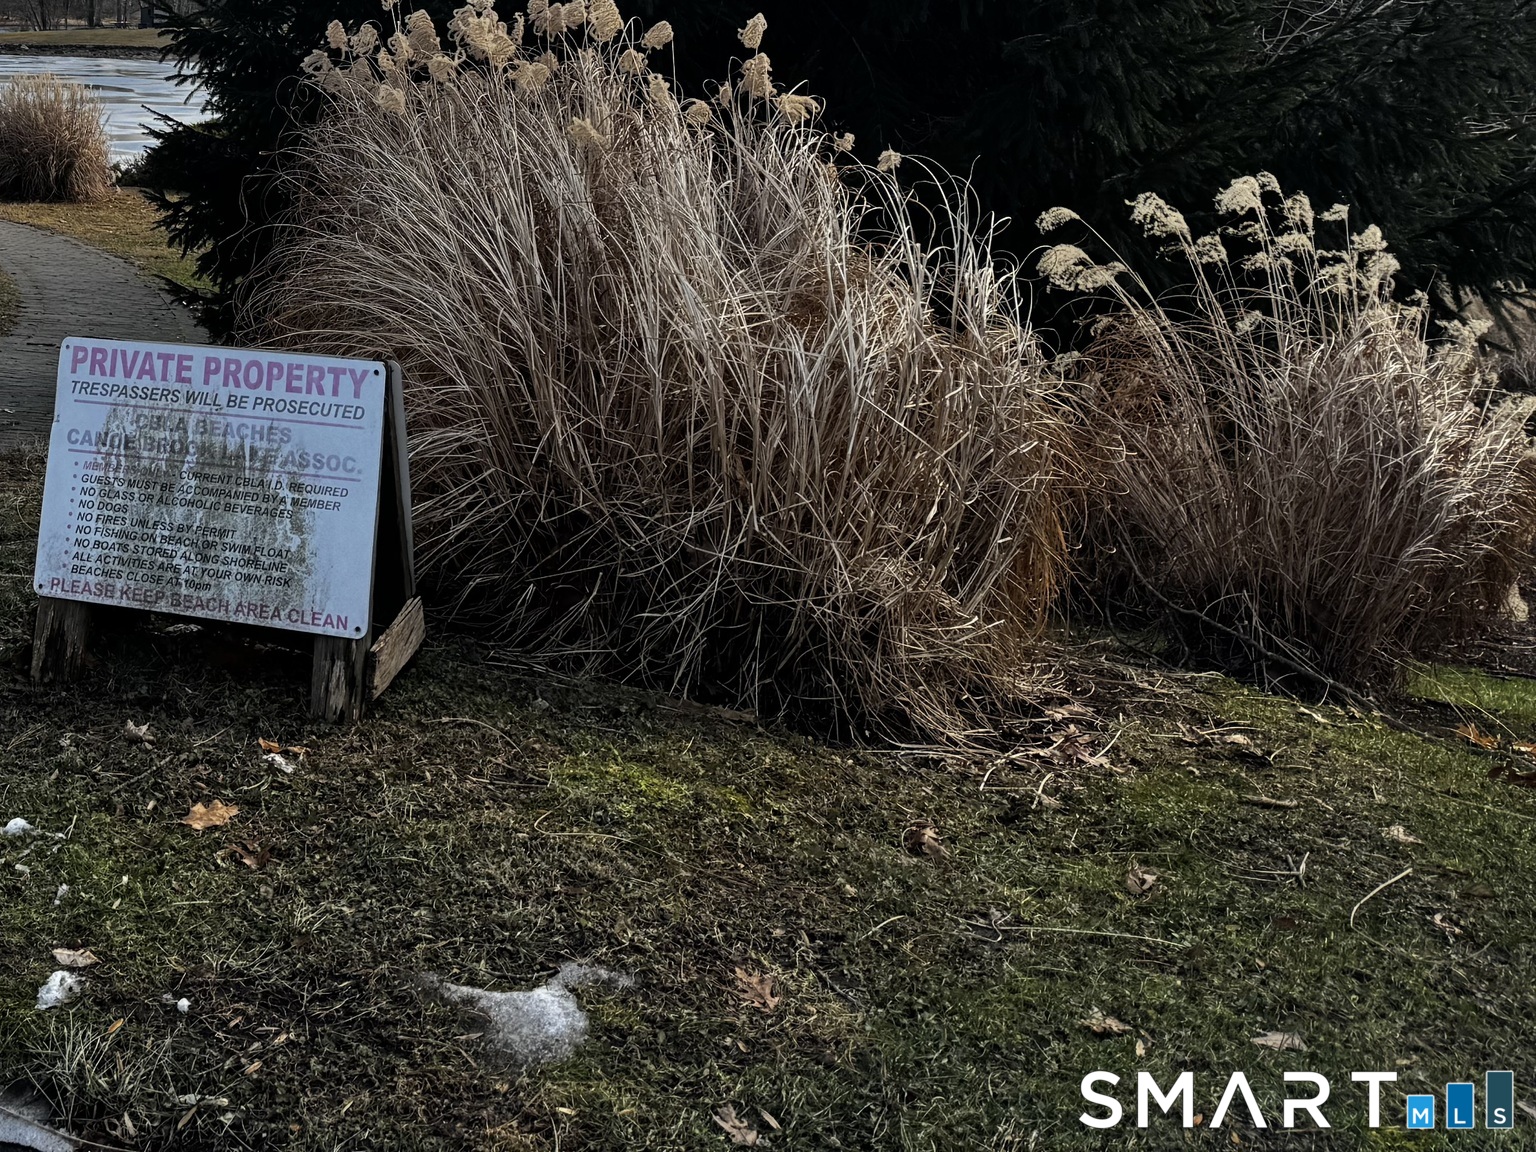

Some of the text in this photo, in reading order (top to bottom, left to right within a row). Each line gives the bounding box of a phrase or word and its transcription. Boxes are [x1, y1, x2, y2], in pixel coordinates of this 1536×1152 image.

[70, 345, 369, 399] PRIVATE PROPERTY
[71, 380, 365, 420] TRESPASSERS WILL BE PROSECUTED
[195, 416, 292, 445] BEACHES
[67, 428, 138, 450] CANOE
[279, 450, 362, 474] ASSOC.
[81, 473, 341, 511] GUESTS MUST BE ACCOMPANIED BY A MEMBER
[83, 461, 138, 475] MEMBERS
[179, 470, 233, 485] CURRENT
[234, 476, 265, 489] CBLA
[289, 482, 349, 498] REQUIRED
[78, 499, 129, 514] NO DOGS
[80, 486, 294, 519] NO GLASS OR ALCOHOLIC BEVERAGES
[75, 524, 291, 559] NO FISHING ON BEACH OR SWIM FLOAT
[76, 512, 237, 539] NO FIRES UNLESS BY PERMIT
[72, 551, 292, 588] ALL ACTIVITIES ARE AT YOUR OWN RISK
[73, 538, 288, 573] NO BOATS STORED ALONG SHORELINE
[71, 564, 212, 592] BEACHES CLOSE AT 10pm
[50, 577, 348, 631] PLEASE KEEP BEACH AREA CLEAN
